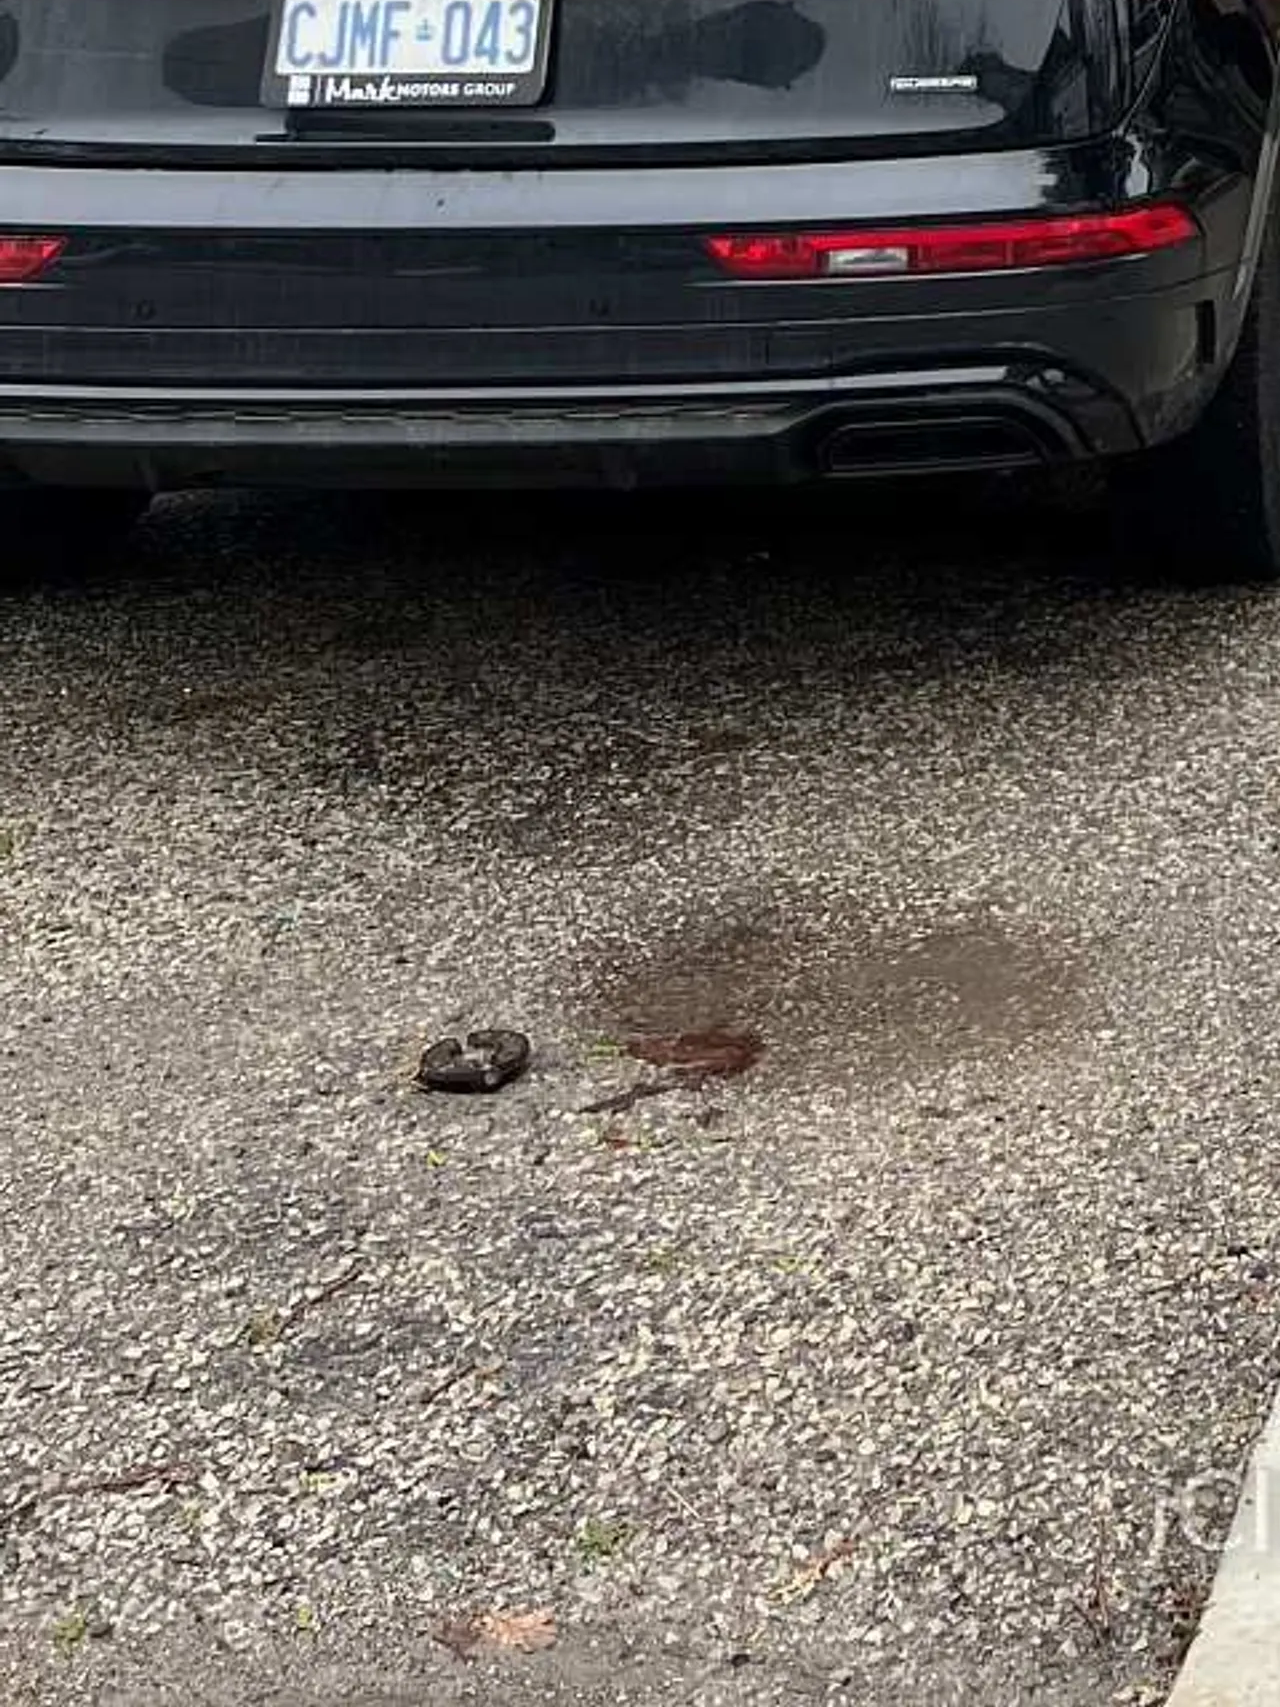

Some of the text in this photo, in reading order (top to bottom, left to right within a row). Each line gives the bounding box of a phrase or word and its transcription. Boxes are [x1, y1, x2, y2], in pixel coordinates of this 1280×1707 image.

[286, 0, 537, 68] CJMF 043
[325, 74, 517, 104] Mark MOTORS GROUP
